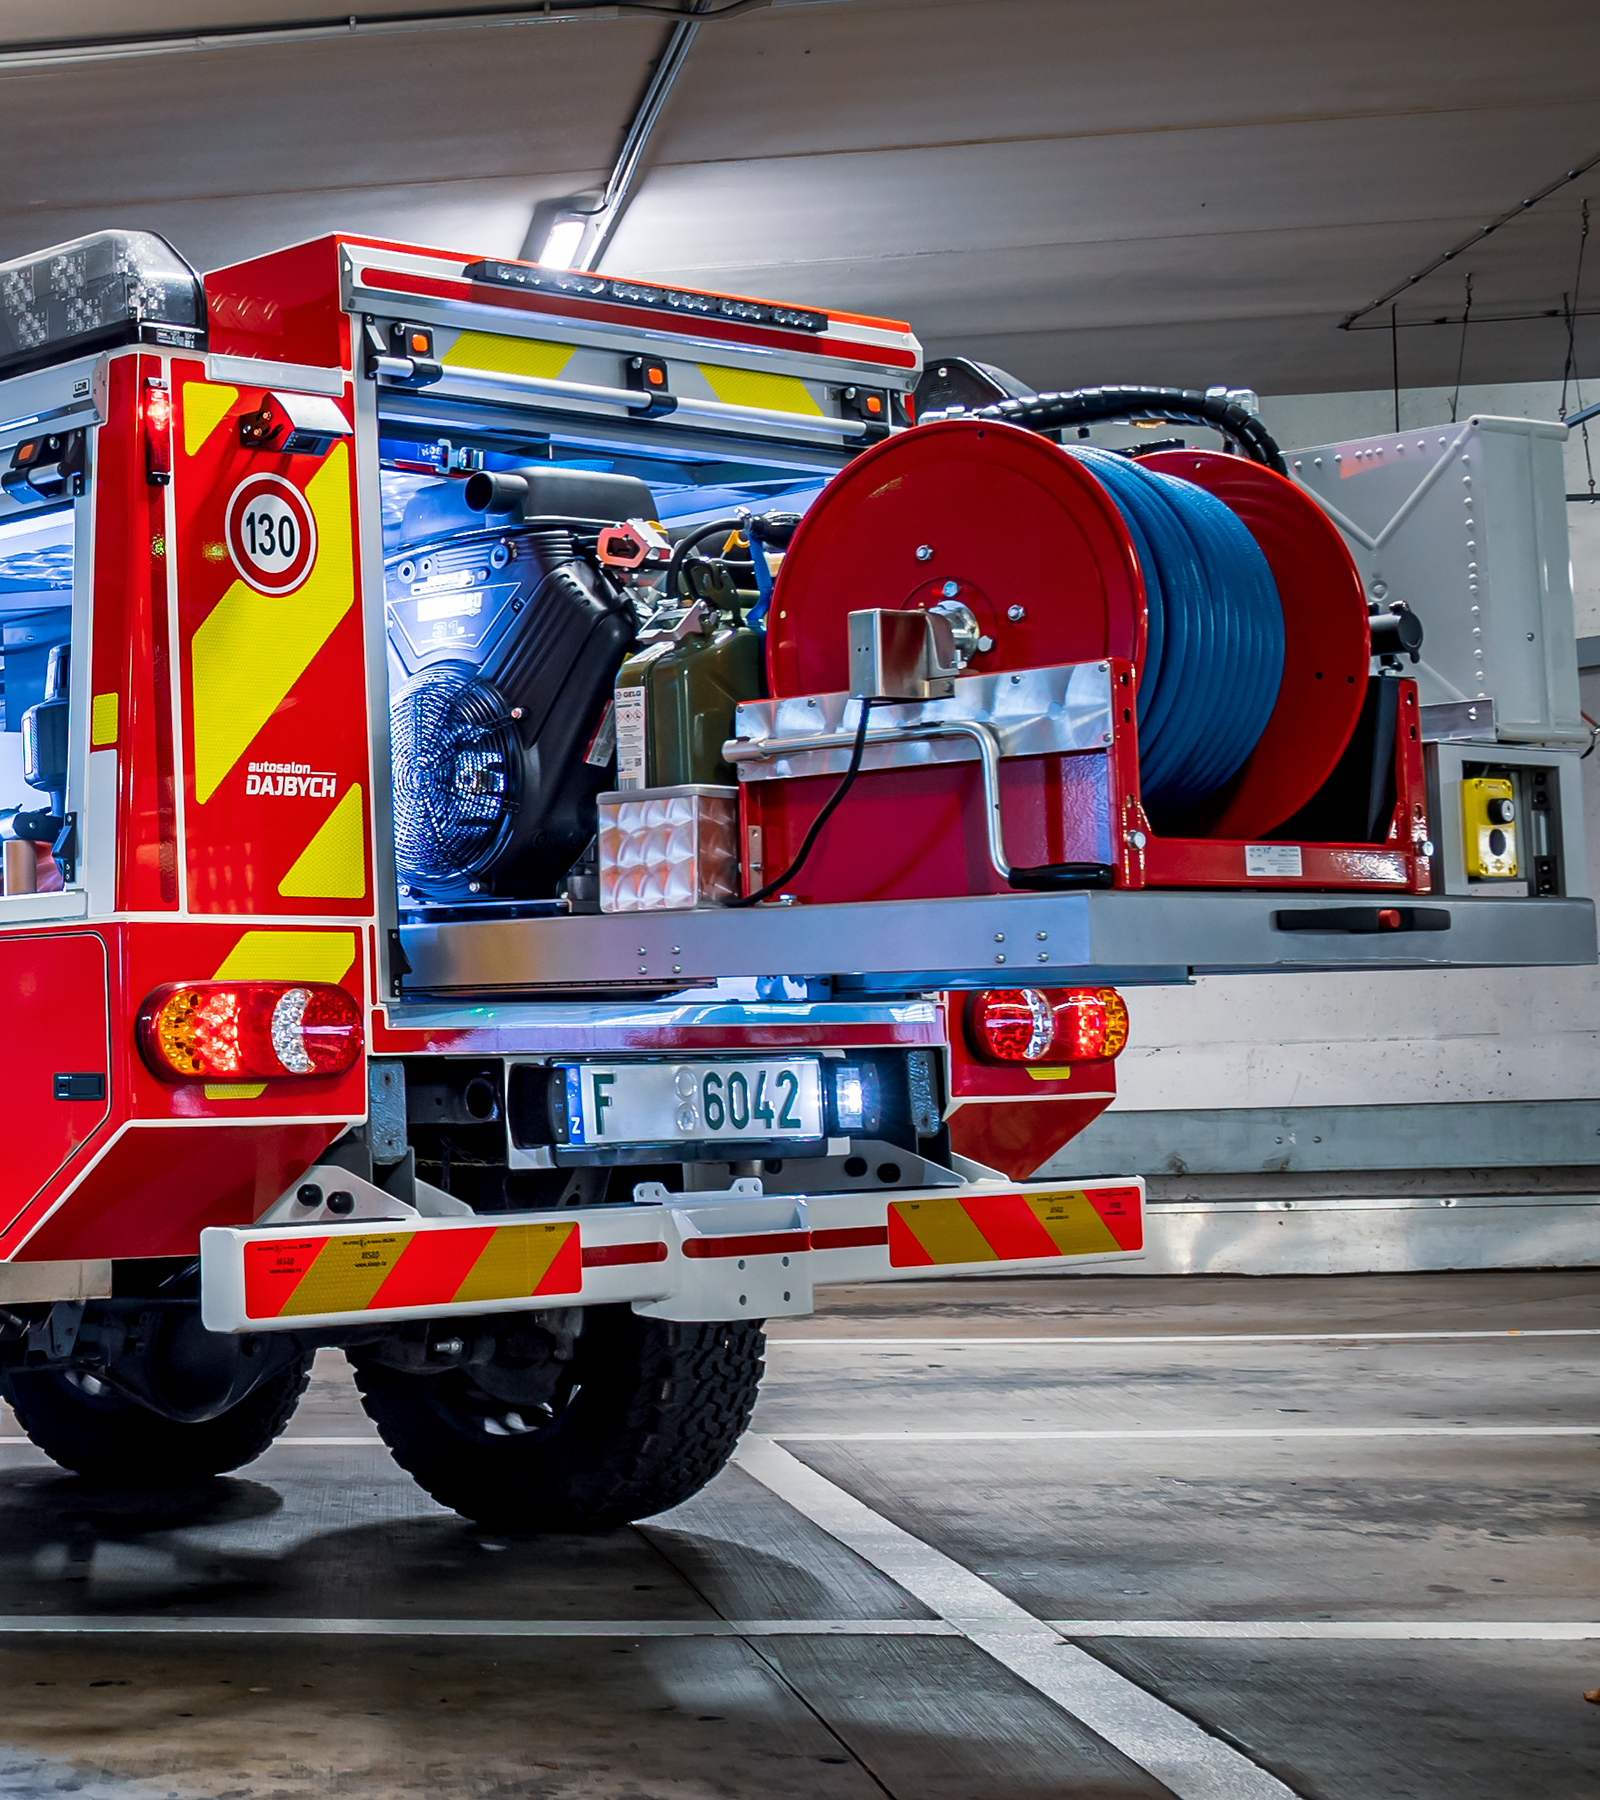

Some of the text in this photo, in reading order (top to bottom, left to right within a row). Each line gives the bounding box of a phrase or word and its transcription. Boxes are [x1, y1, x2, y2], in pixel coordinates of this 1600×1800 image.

[245, 511, 296, 558] 130
[247, 761, 311, 775] autosalon
[245, 774, 337, 798] DAJBYCH
[702, 1070, 802, 1131] 6042
